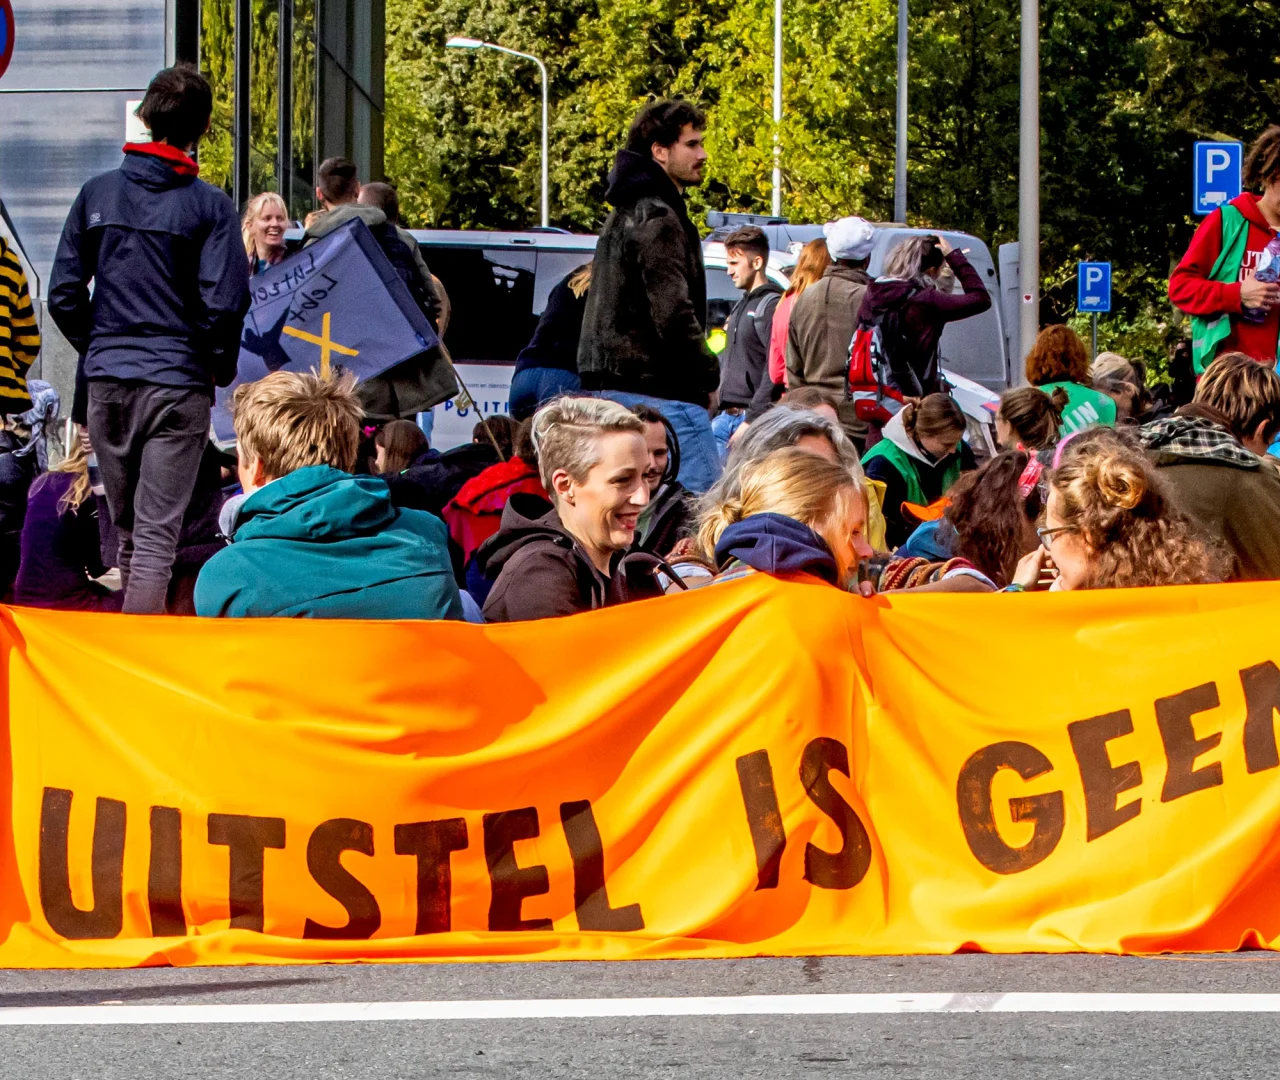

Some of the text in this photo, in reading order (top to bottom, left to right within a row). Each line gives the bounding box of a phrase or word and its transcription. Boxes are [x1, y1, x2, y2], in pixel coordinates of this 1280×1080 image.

[1206, 149, 1231, 184] P
[1086, 267, 1103, 291] P
[445, 400, 509, 417] POLITI
[39, 786, 644, 940] UITSTEL
[736, 737, 871, 891] IS
